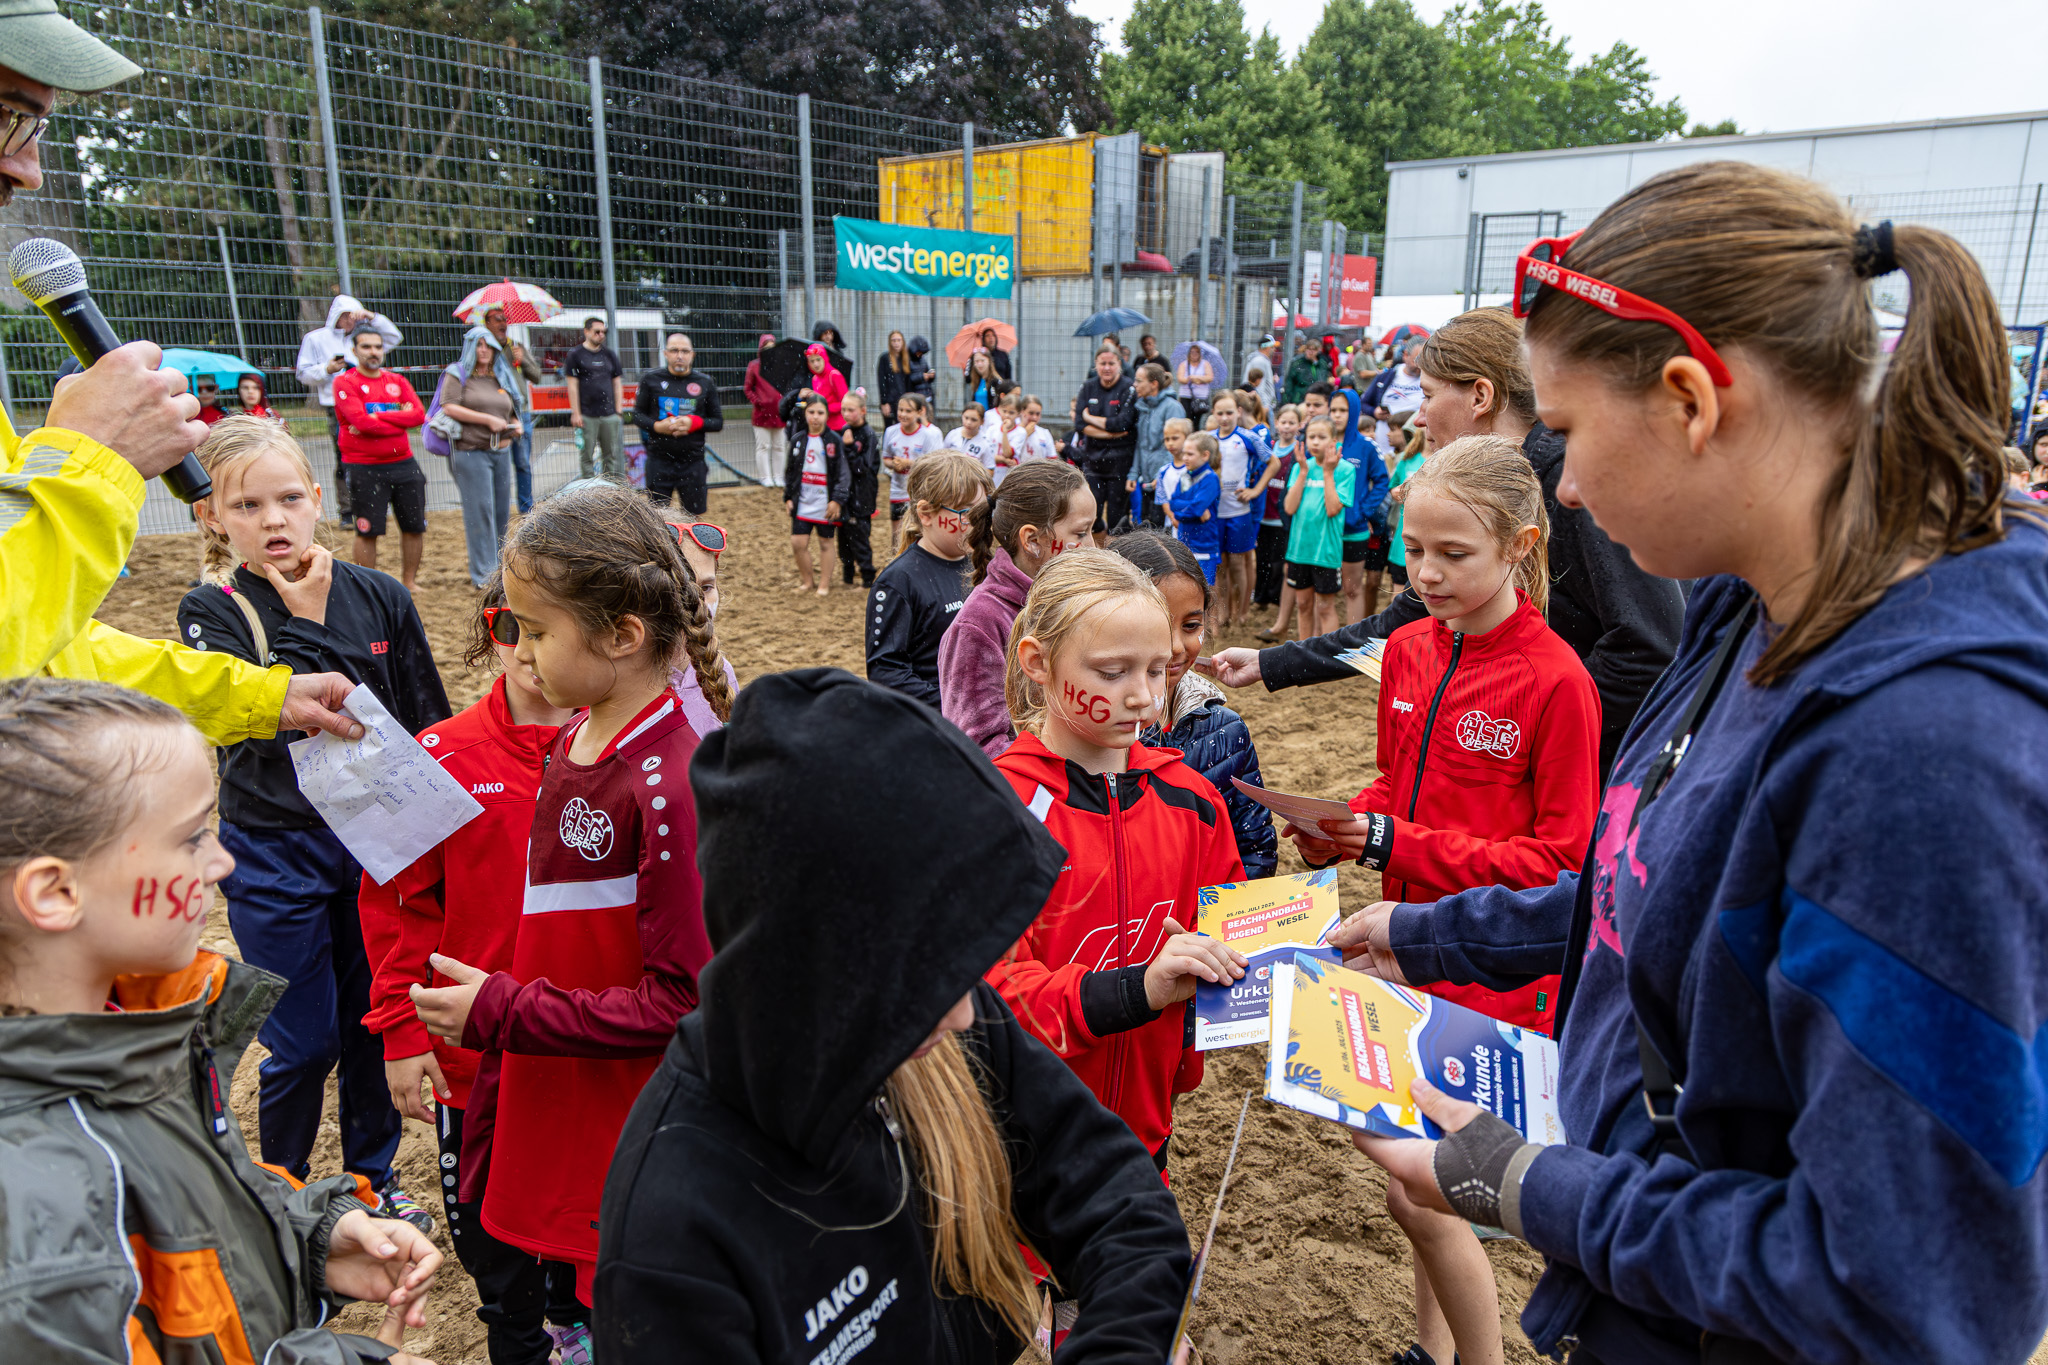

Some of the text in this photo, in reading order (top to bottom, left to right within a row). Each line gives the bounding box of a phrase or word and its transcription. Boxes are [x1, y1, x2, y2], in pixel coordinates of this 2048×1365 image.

[845, 240, 1010, 288] westenergie
[1526, 261, 1619, 309] HSG WESEL
[806, 449, 815, 464] 5
[969, 443, 981, 455] 20
[944, 600, 963, 613] JAKO
[1064, 680, 1112, 724] HSG
[1464, 720, 1514, 747] HSG
[1465, 736, 1504, 751] WESEL
[471, 782, 504, 794] JAKO
[564, 807, 604, 846] HSG
[132, 874, 203, 923] HSG
[1247, 905, 1260, 913] JULI
[1261, 901, 1275, 909] 2025
[1227, 901, 1309, 929] BEACHHANDBALL
[1277, 912, 1309, 928] WESEL
[1226, 925, 1264, 941] JUGEND
[1231, 984, 1269, 999] Urku
[1236, 998, 1269, 1006] Westenerg
[1365, 1002, 1381, 1032] WESEL
[1205, 1028, 1266, 1043] westenergie
[1344, 994, 1372, 1080] BEACHHANDBALL
[1373, 1044, 1393, 1090] JUGEND
[1470, 1044, 1492, 1112] rkunde
[1493, 1049, 1505, 1119] estenergie Beach Cup
[804, 1265, 869, 1342] JAKO
